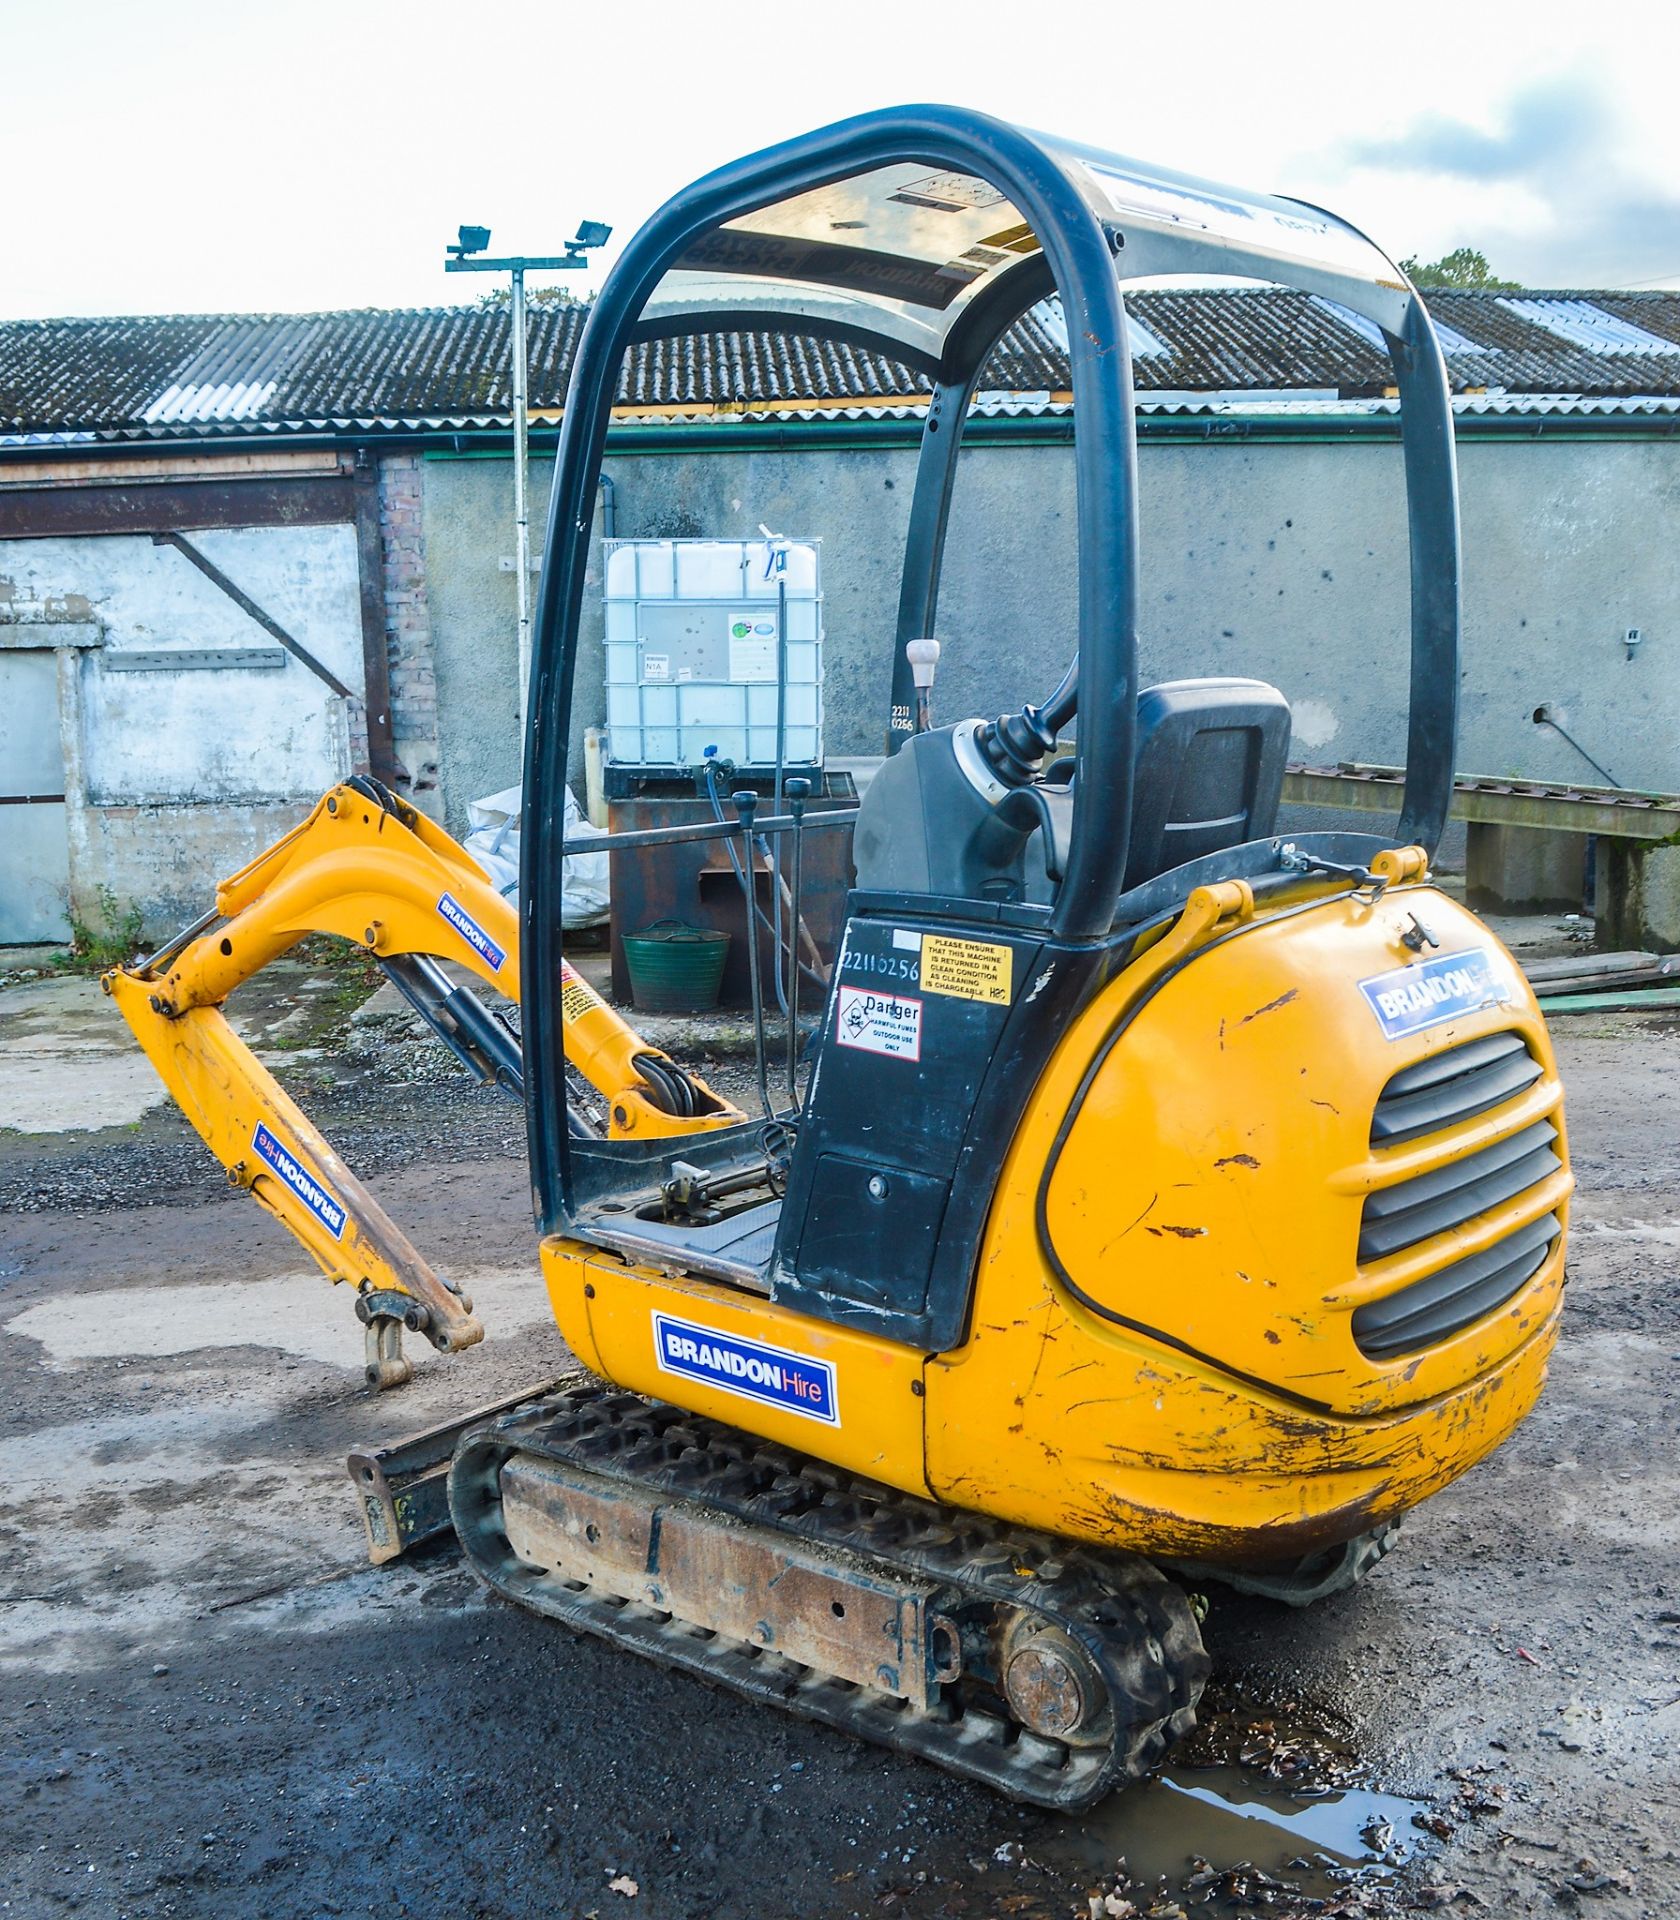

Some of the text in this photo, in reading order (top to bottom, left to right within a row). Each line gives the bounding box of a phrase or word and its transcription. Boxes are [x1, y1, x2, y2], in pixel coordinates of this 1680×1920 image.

[891, 705, 910, 717] 2211
[440, 899, 485, 951] BRANDON
[935, 939, 995, 954] PLEASE ENSURE
[928, 946, 1001, 963] THAT THIS MACHINE
[940, 957, 980, 969] RETURNED
[930, 964, 998, 981] CLEAN CONDITION
[942, 974, 980, 986] CLEANING
[935, 982, 984, 996] CHARGEABLE
[1375, 968, 1475, 1020] BRANDON
[871, 1020, 917, 1033] HARMFUL FUMES
[873, 1030, 913, 1044] OUTDOOR USE
[884, 1043, 900, 1051] ONLY
[277, 1153, 341, 1229] BRANDON
[666, 1333, 822, 1403] BRANDON Hire
